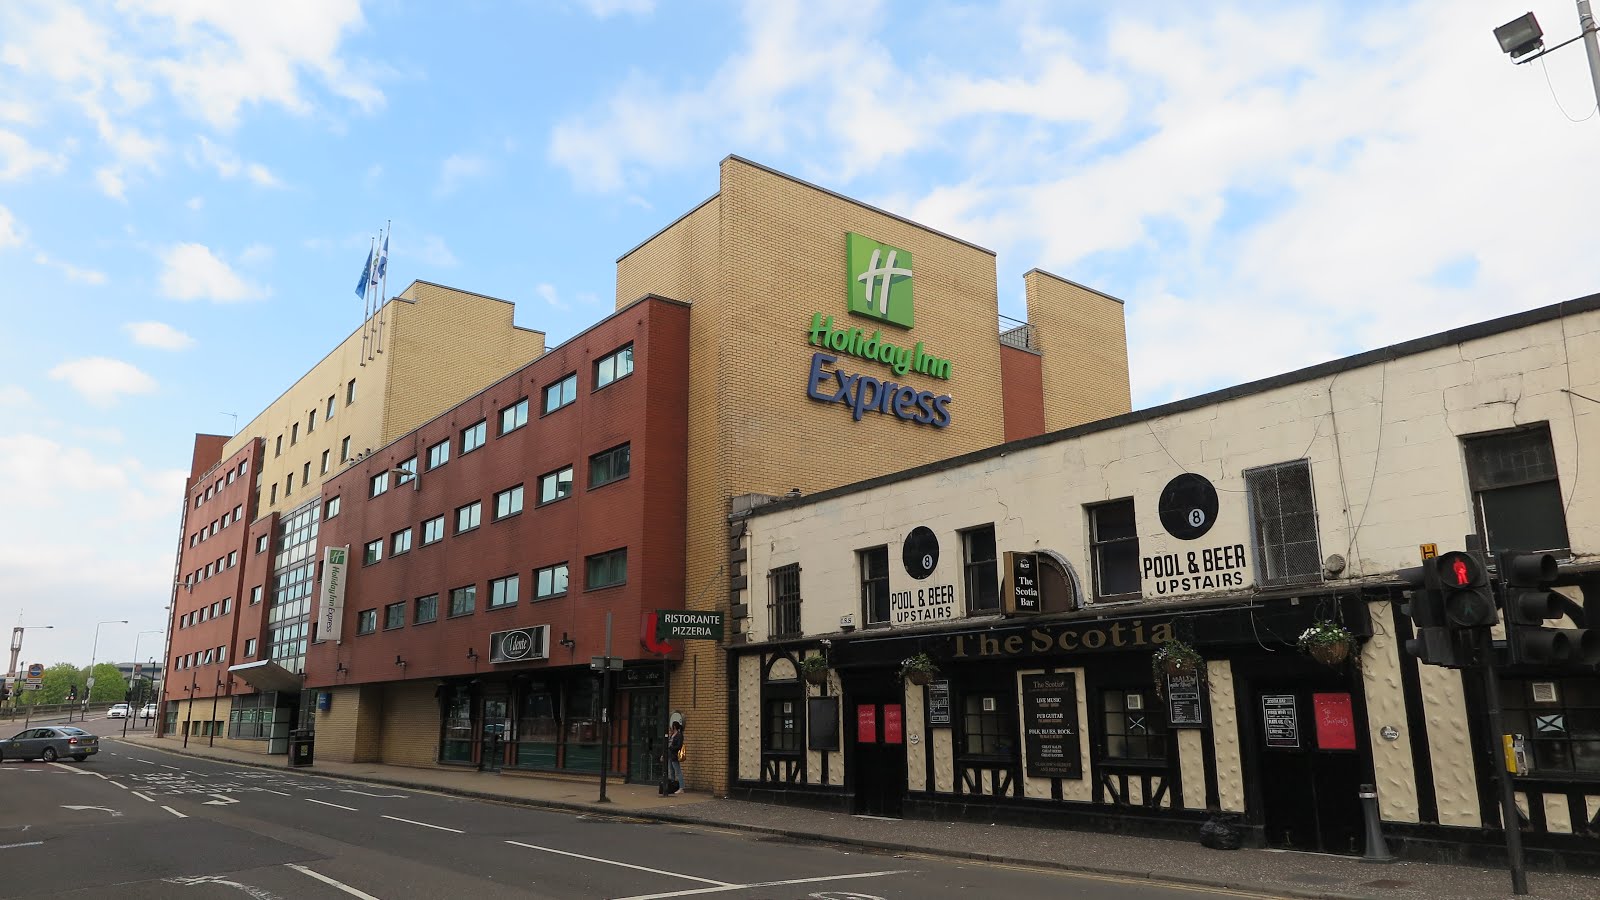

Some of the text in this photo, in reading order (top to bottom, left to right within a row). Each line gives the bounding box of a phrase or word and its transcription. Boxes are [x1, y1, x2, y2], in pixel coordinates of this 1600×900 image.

[809, 312, 952, 380] Holiday Inn
[807, 352, 952, 428] Express
[1193, 510, 1201, 524] 8
[1143, 544, 1246, 579] POOL & BEER
[1019, 576, 1034, 585] The
[1156, 572, 1243, 594] UPSTAIRS
[326, 566, 340, 633] Holiday Inn Express
[891, 585, 954, 610] POOL & BEER
[1015, 587, 1038, 597] Scotia
[1020, 598, 1035, 606] Bar
[664, 613, 720, 625] RISTORANTE
[897, 606, 952, 622] UPSTAIRS
[672, 626, 712, 636] PIZZERIA
[947, 620, 1176, 658] The Scotia
